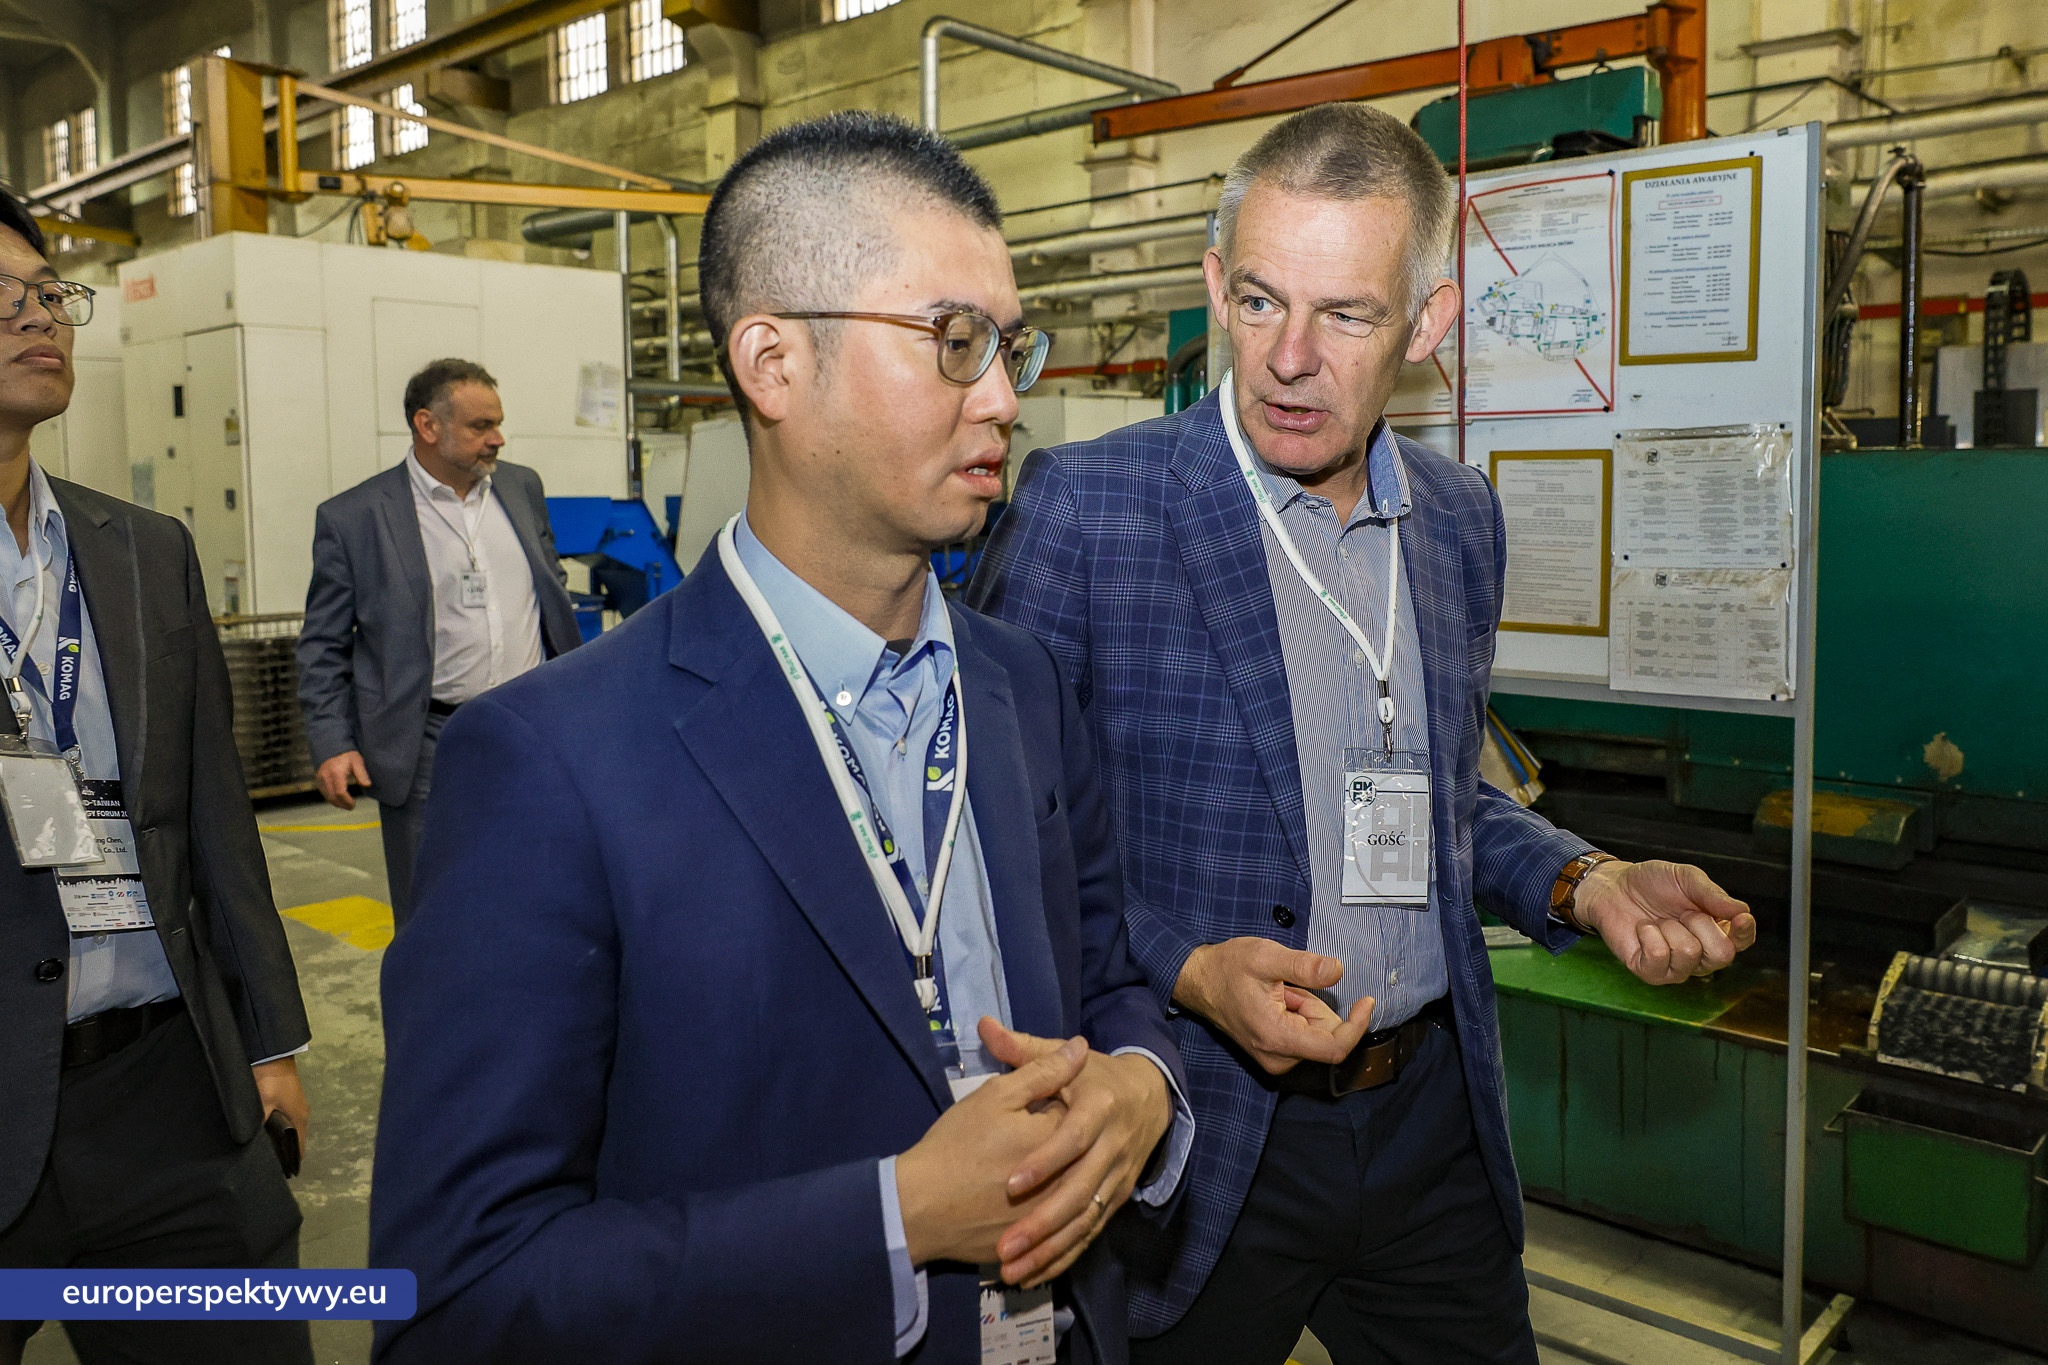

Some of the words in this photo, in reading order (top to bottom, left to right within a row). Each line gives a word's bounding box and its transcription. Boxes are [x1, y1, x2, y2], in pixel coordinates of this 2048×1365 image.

[59, 656, 75, 701] KOMAG
[934, 693, 955, 759] KOMAG
[1367, 830, 1406, 847] GOŚĆ
